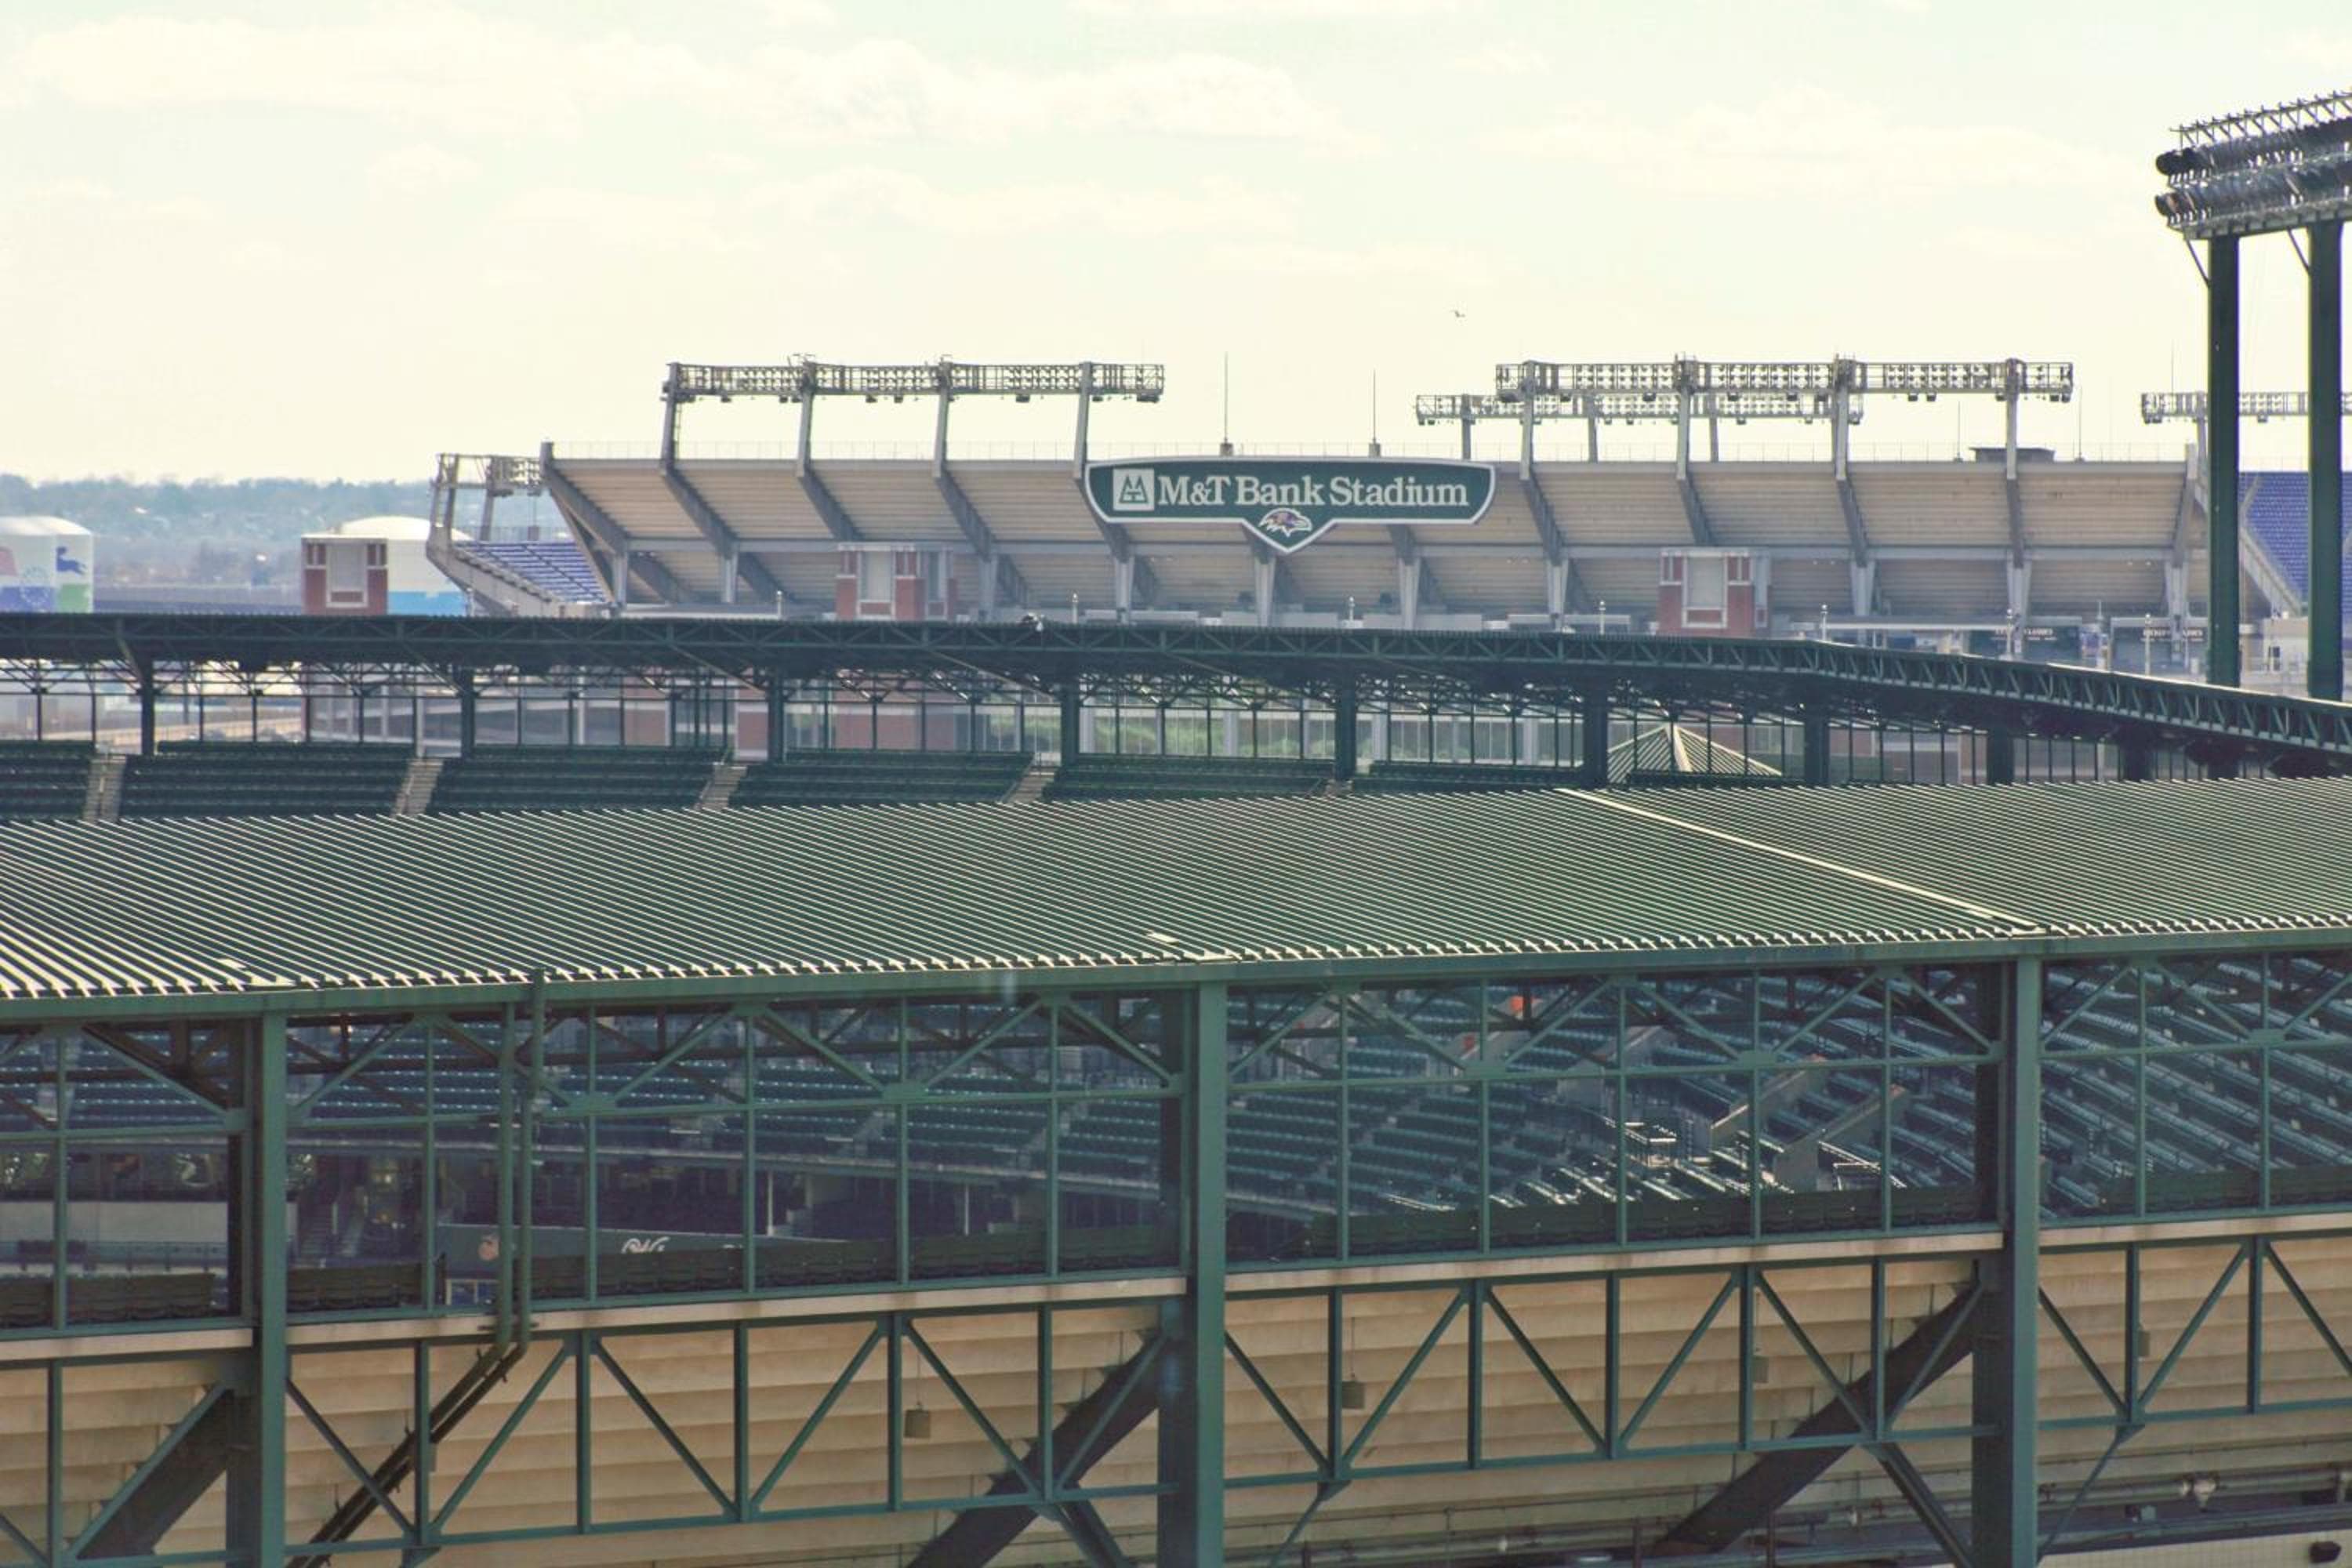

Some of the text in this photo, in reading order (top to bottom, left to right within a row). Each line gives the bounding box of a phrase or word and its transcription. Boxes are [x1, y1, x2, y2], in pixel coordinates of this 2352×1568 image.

[1157, 475, 1469, 506] M&T Bank Stadium
